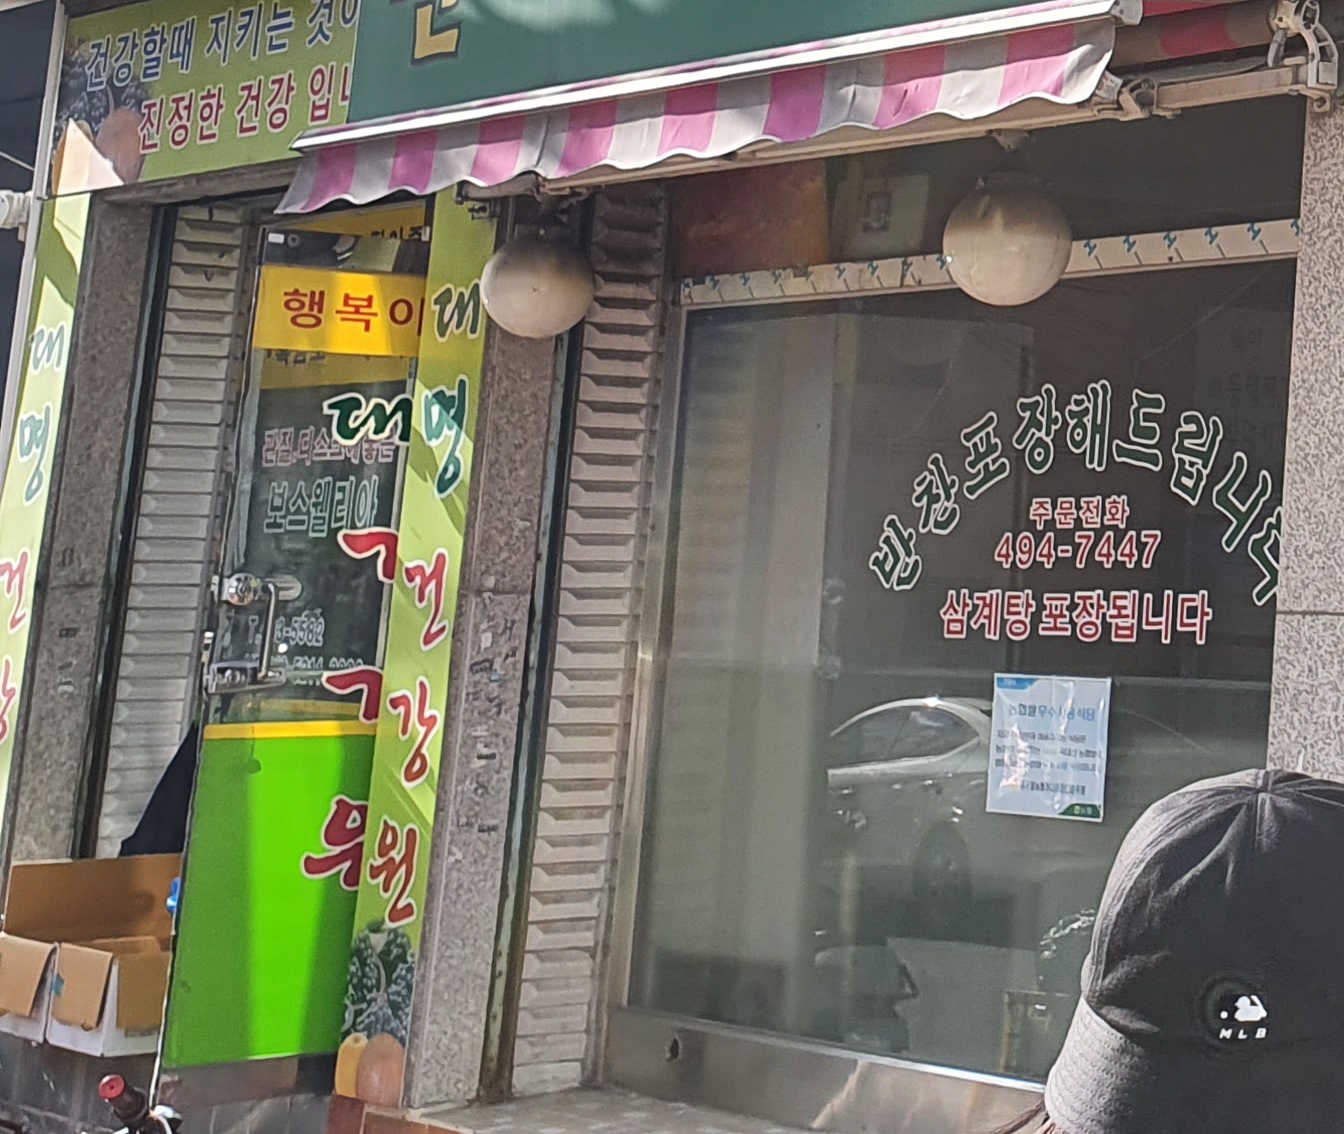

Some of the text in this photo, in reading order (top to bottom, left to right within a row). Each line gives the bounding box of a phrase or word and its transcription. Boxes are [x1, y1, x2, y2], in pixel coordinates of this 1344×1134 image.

[85, 19, 195, 91] 건강할때
[206, 1, 295, 65] 지키는
[139, 100, 225, 154] 진정한
[234, 73, 295, 134] 건강
[1029, 495, 1130, 530] 주문전화
[994, 530, 1162, 570] 494-7447
[939, 588, 1213, 646] 삼계탕 포장됩니다
[1218, 1028, 1267, 1040] MLB
